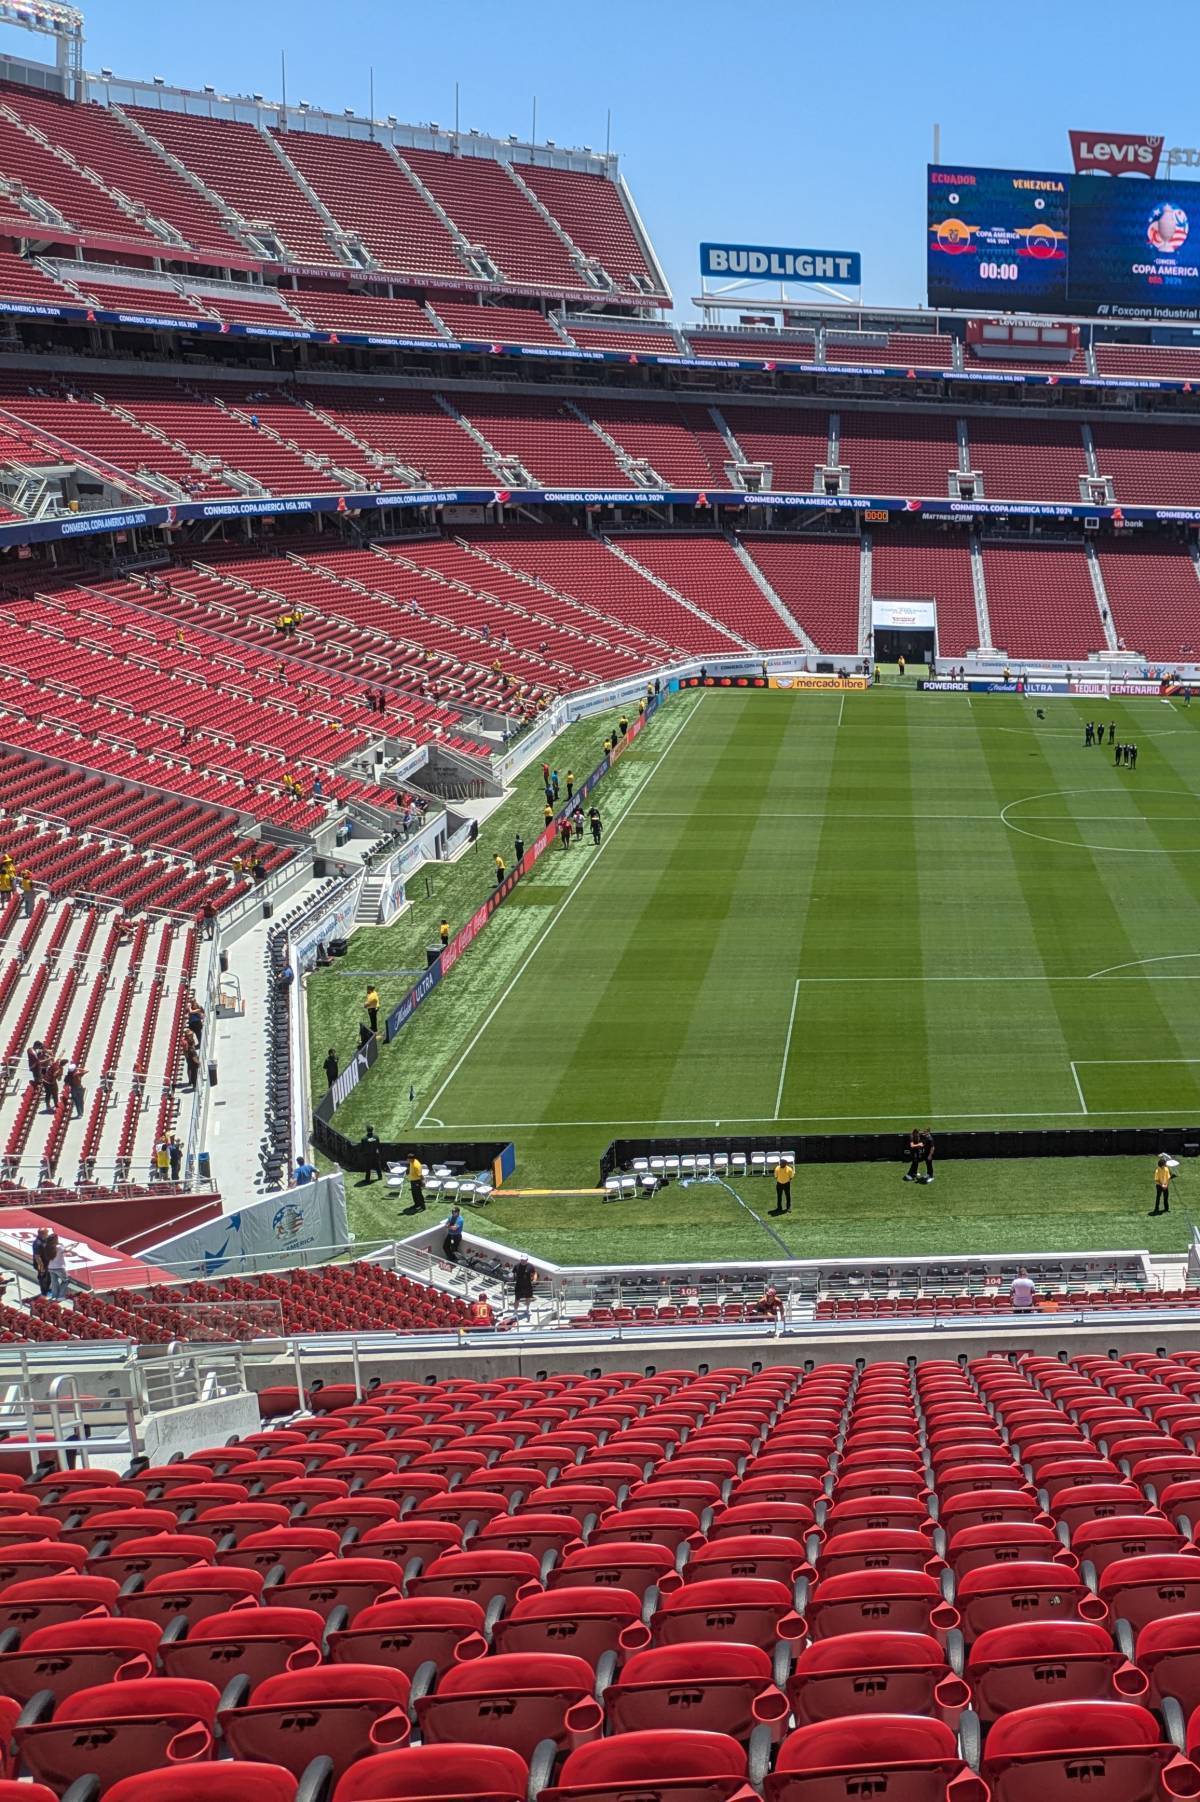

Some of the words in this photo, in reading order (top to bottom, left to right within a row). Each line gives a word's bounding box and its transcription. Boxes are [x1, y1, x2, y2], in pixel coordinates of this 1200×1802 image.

[931, 172, 976, 185] ECUADOR
[1012, 179, 1064, 192] VENEZUELA
[980, 262, 1018, 280] 00:00
[1132, 264, 1156, 275] COPA
[1158, 265, 1198, 277] AMERICA
[1112, 305, 1151, 316] Foxconn
[1154, 307, 1198, 318] Industrial
[544, 493, 584, 501] CONMEBOL
[744, 496, 785, 504] CONMEBOL
[785, 497, 804, 505] COPA
[805, 498, 837, 506] AMERICA
[204, 504, 240, 515] CONMEBOL
[240, 503, 256, 513] COPA
[256, 502, 285, 512] AMERICA
[950, 503, 989, 511] CONMEBOL
[990, 504, 1009, 512] COPA
[1010, 505, 1040, 513] AMERICA
[1157, 511, 1194, 519] CONMEBOL
[61, 522, 90, 534] CONMEBOL
[90, 519, 104, 530] COPA
[104, 516, 125, 528] AMERICA
[1125, 519, 1143, 528] bank
[797, 679, 840, 689] mercado
[842, 678, 863, 688] libre
[923, 682, 969, 690] POWERADE
[1074, 684, 1107, 693] TEQUILA
[1110, 685, 1160, 695] CENTENARIO
[415, 973, 434, 1003] ULTRA
